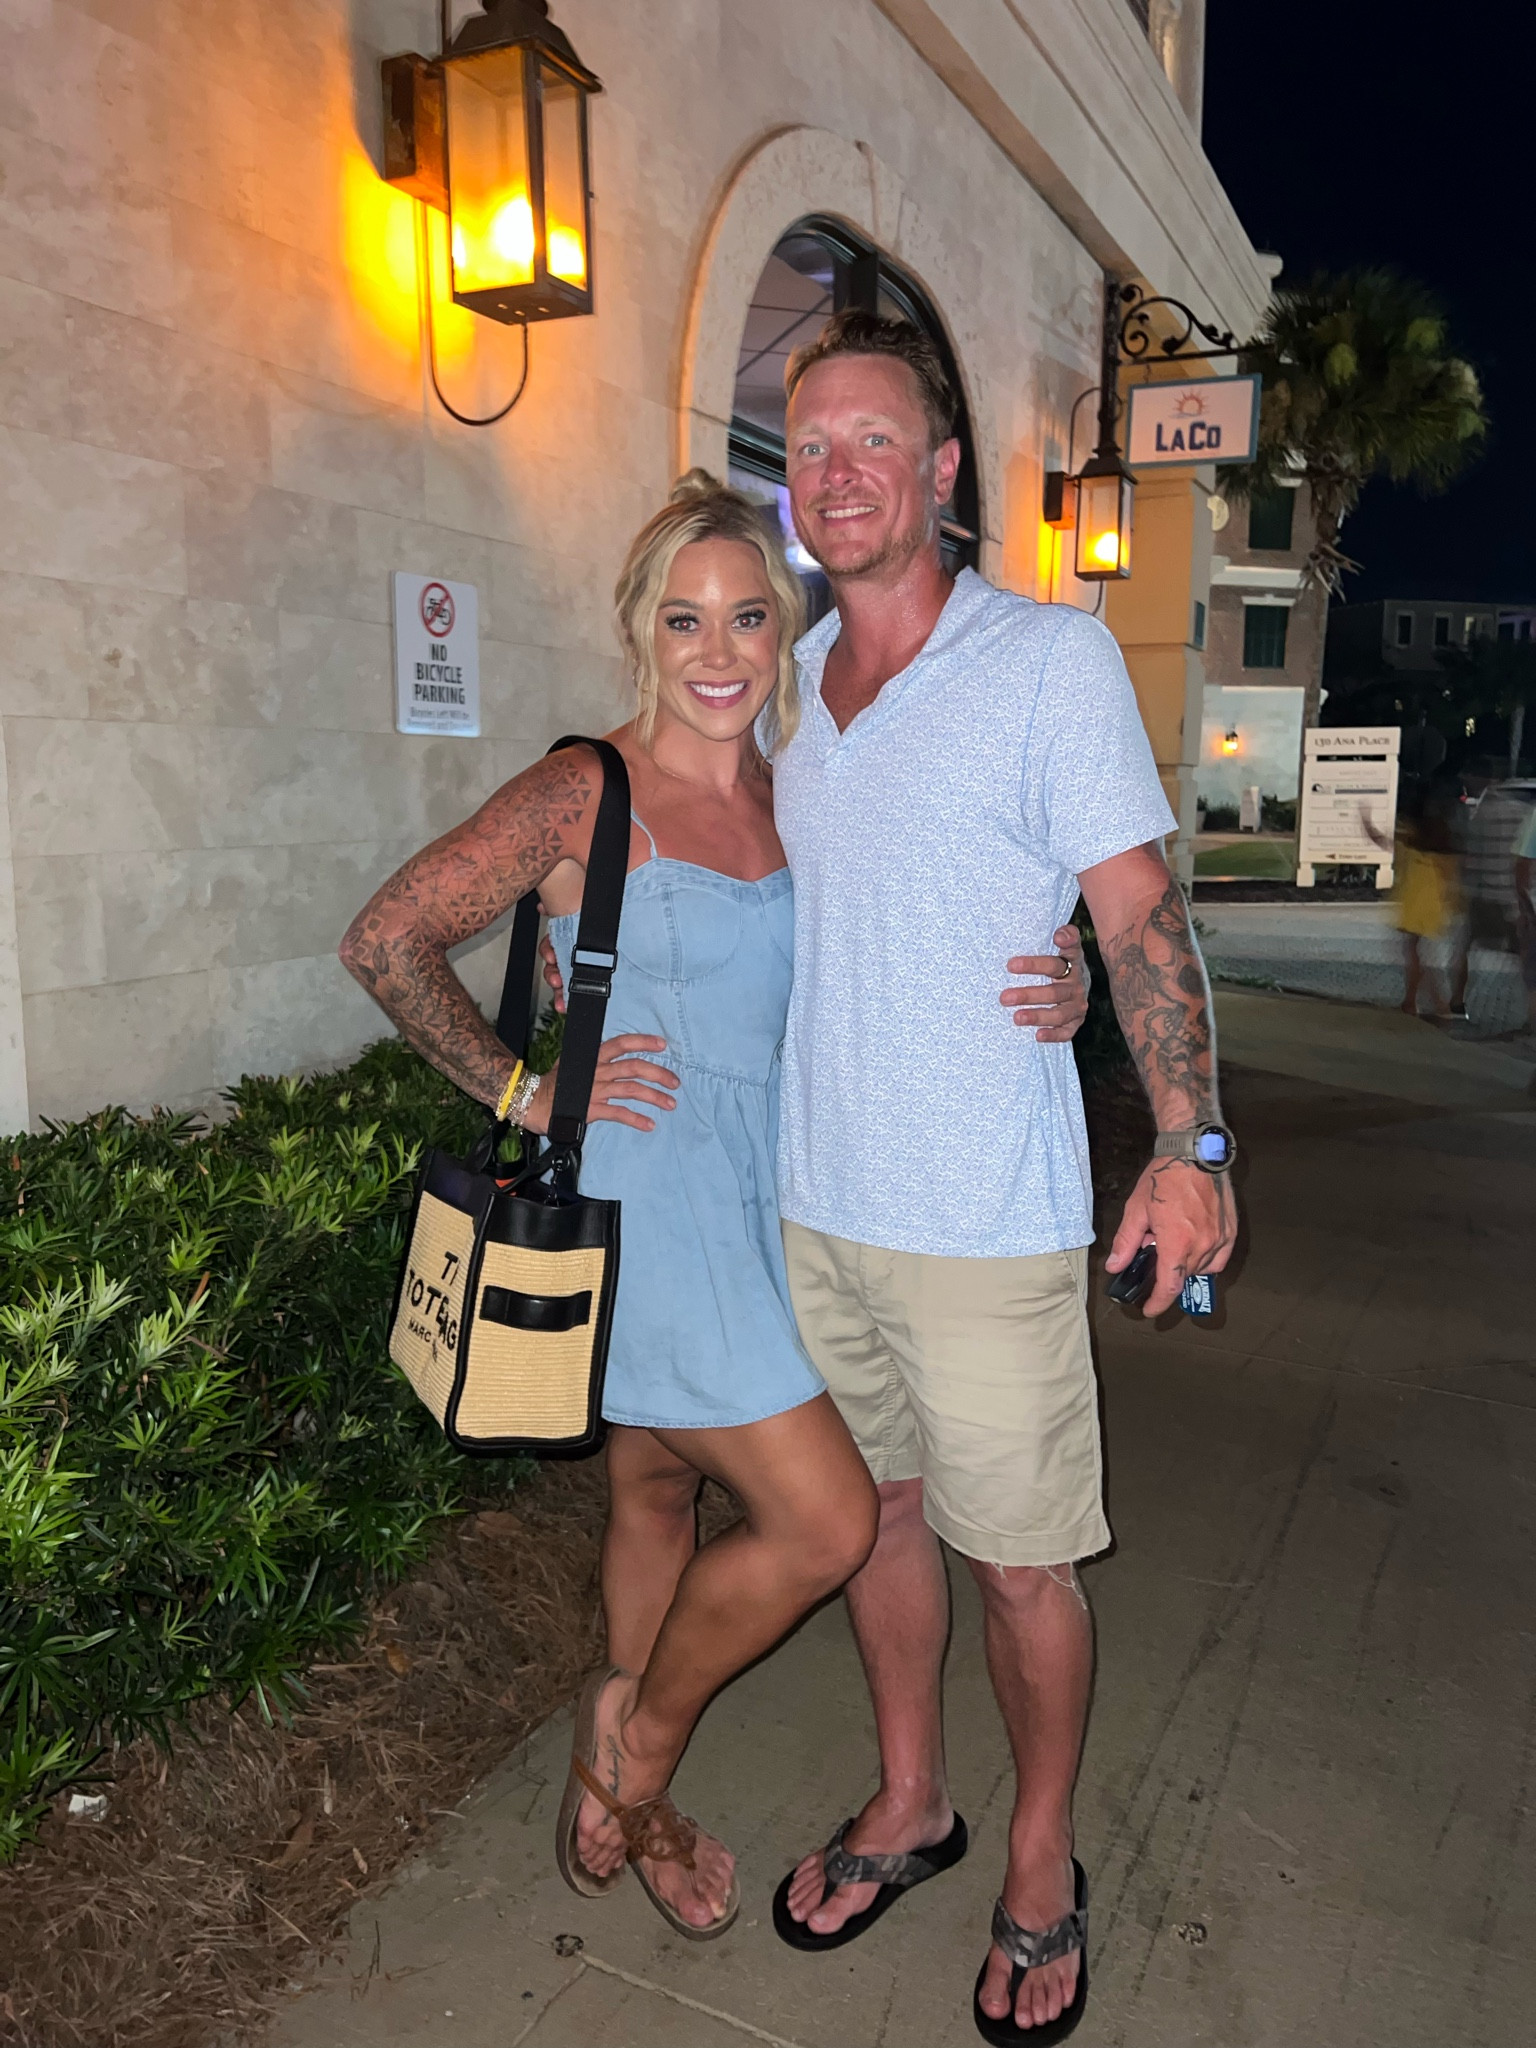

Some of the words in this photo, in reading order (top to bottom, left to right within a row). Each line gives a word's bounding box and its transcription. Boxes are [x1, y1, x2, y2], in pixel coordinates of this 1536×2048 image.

[429, 643, 447, 662] NO
[414, 662, 463, 684] BICYCLE
[413, 683, 466, 705] PARKING
[408, 1318, 432, 1343] MARC
